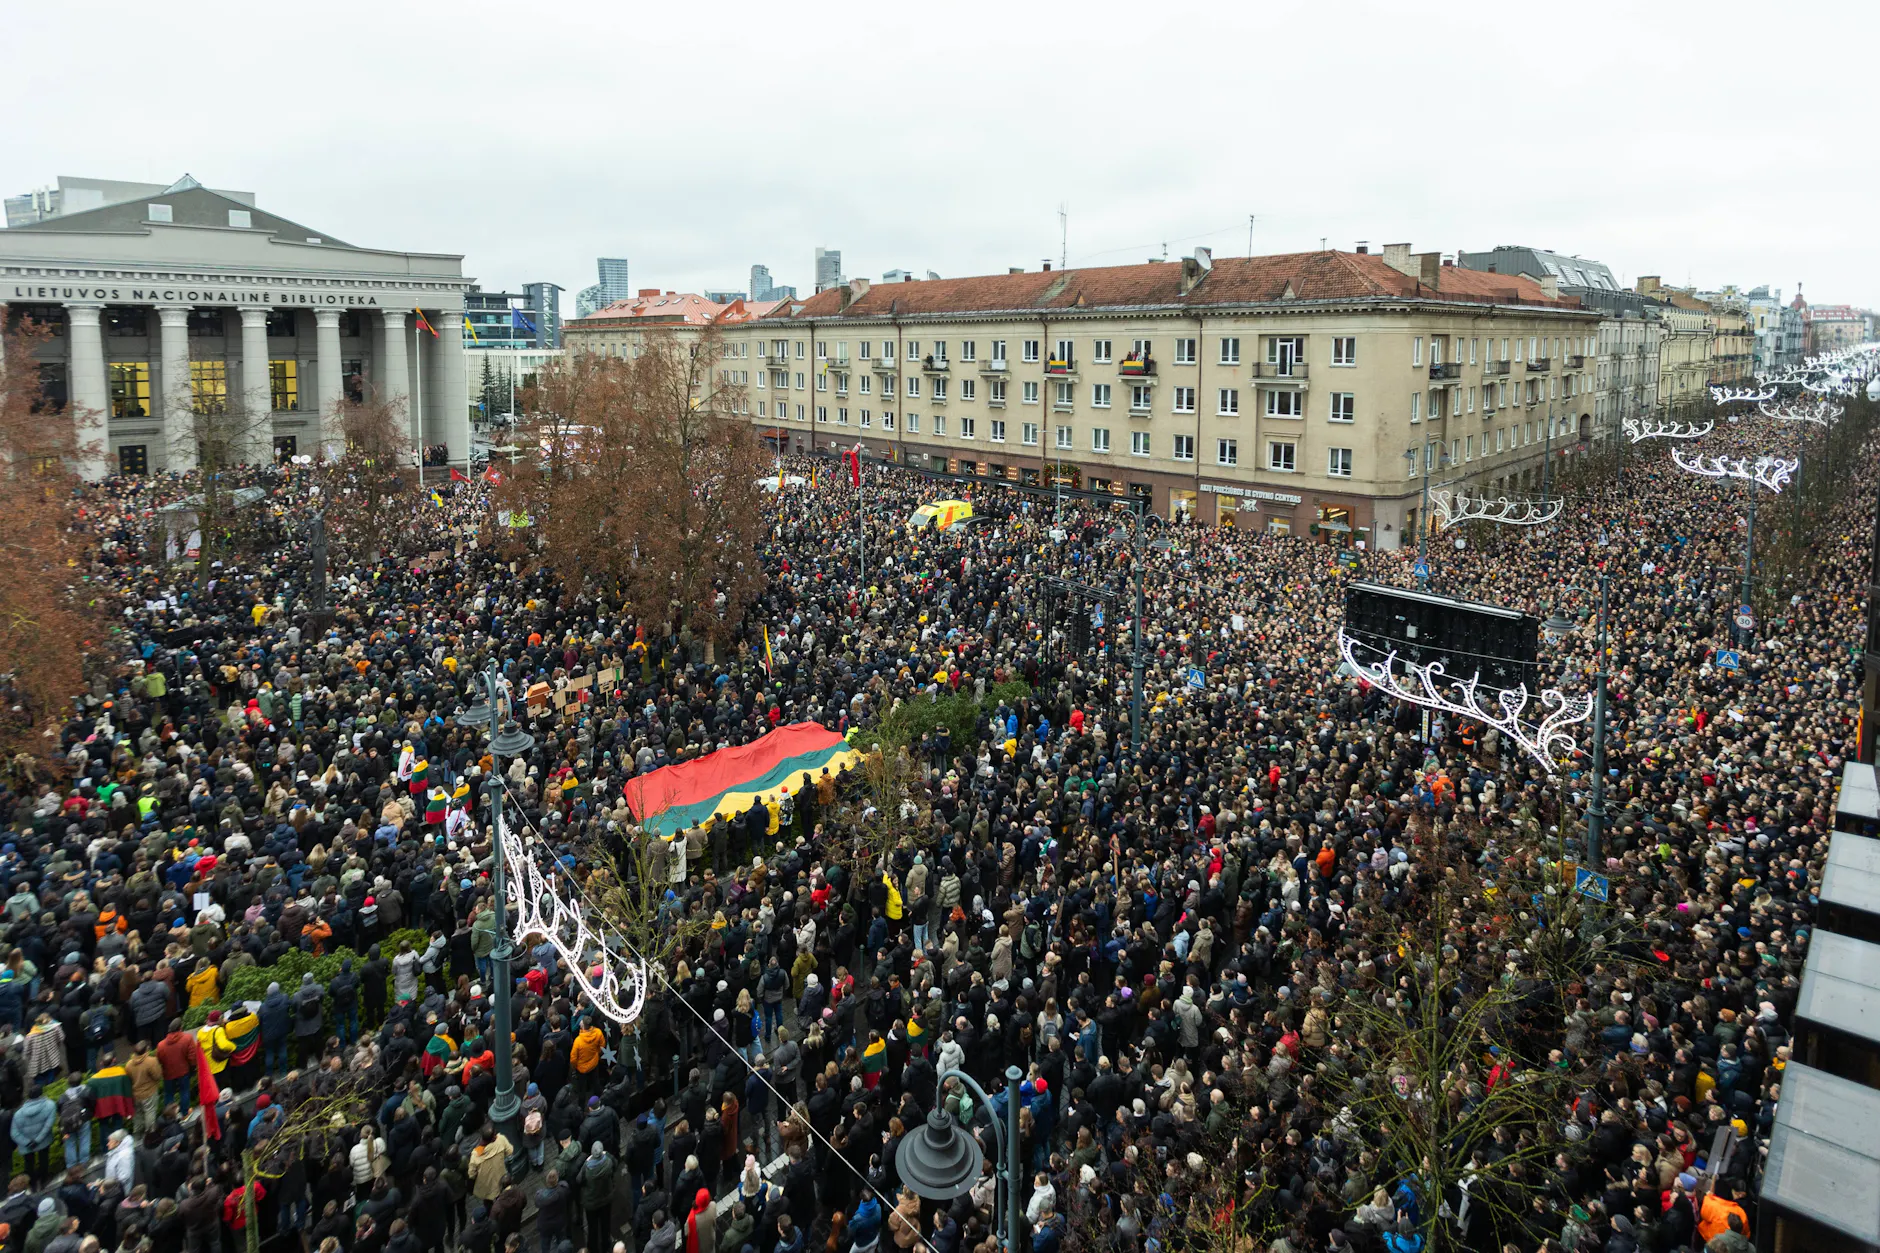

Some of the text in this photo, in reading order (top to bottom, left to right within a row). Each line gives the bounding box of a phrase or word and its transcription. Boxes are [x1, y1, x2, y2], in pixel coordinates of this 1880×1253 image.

[15, 286, 377, 305] LIETUVOS NACIONALINĖ BIBLIOTEKA
[1275, 493, 1302, 503] CENTRAS
